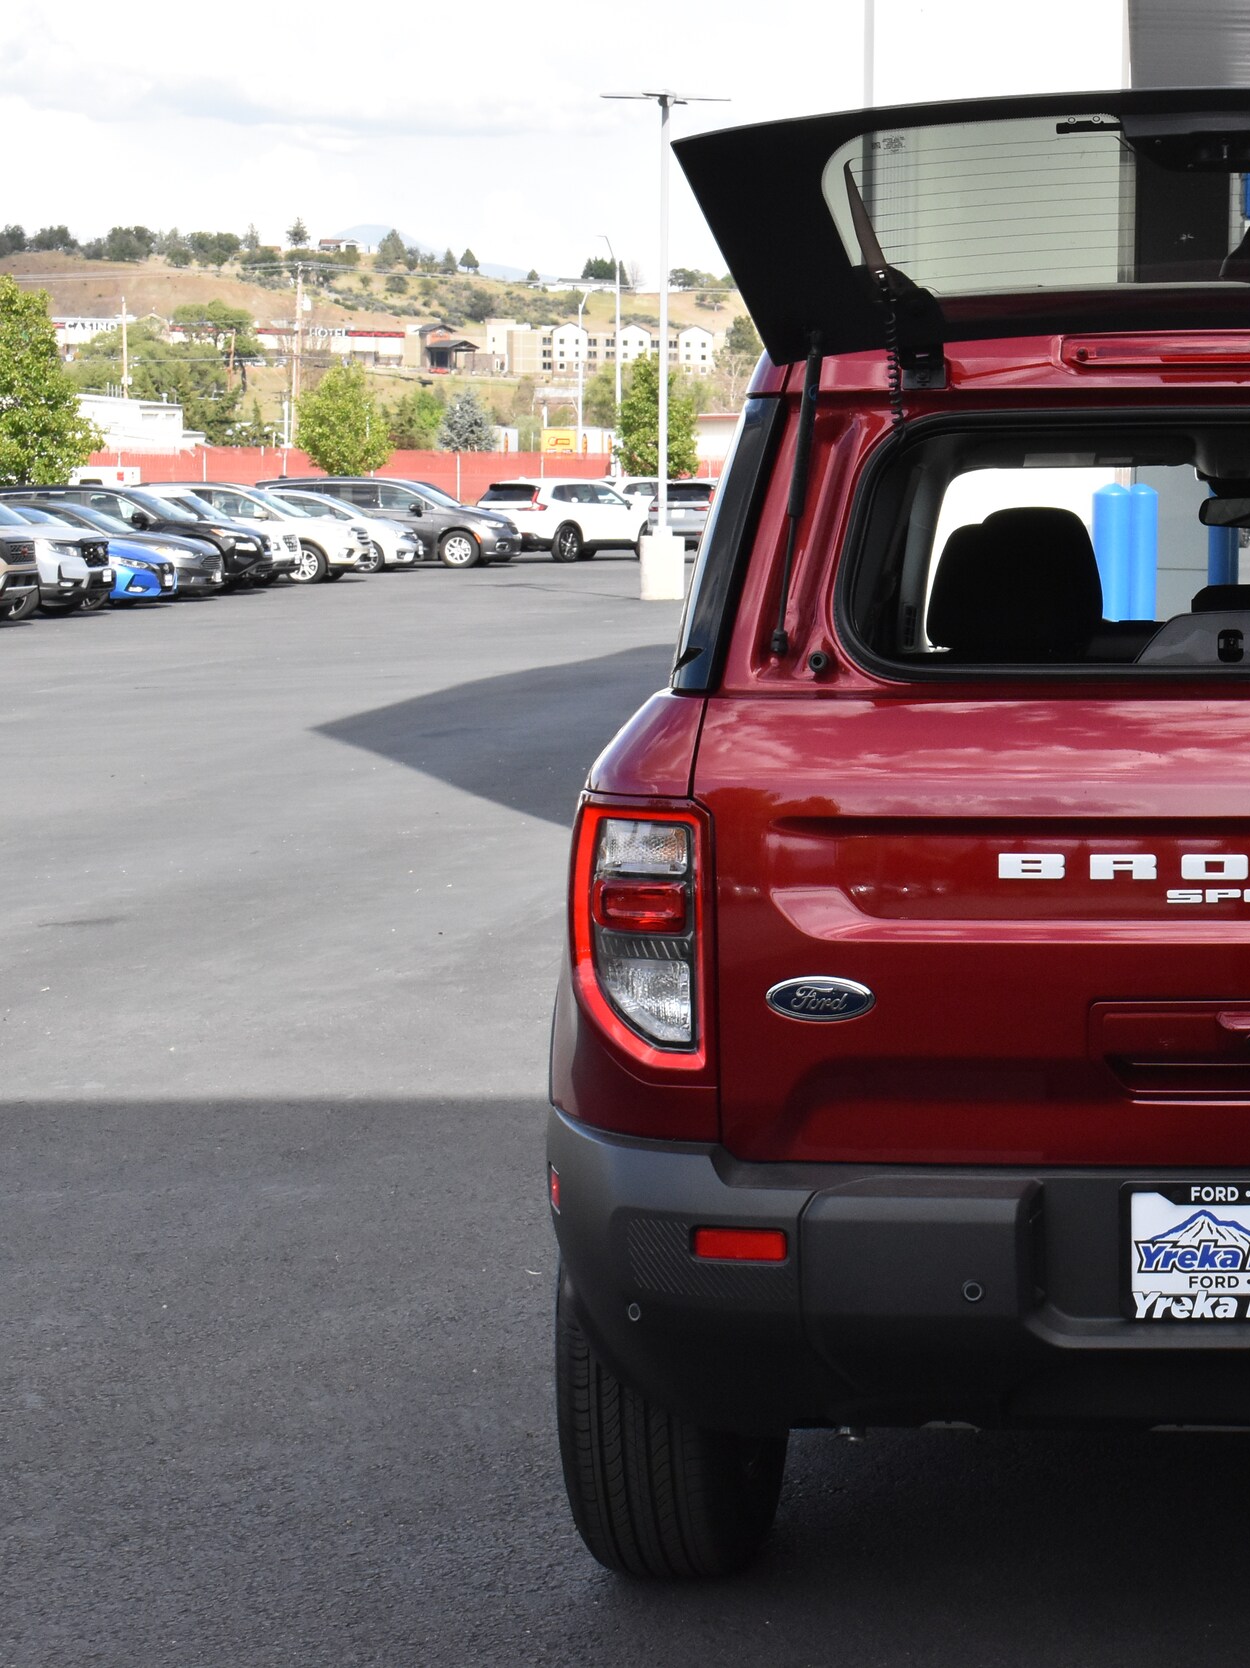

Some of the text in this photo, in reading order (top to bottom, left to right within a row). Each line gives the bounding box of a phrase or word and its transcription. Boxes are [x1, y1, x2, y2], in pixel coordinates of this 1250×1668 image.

[65, 321, 118, 332] CASINO
[310, 328, 347, 339] HOTEL
[790, 985, 848, 1010] Ford
[1190, 1186, 1239, 1202] FORD
[1136, 1240, 1243, 1272] Yreka
[1188, 1275, 1239, 1289] FORD
[1132, 1290, 1238, 1319] Yreka
